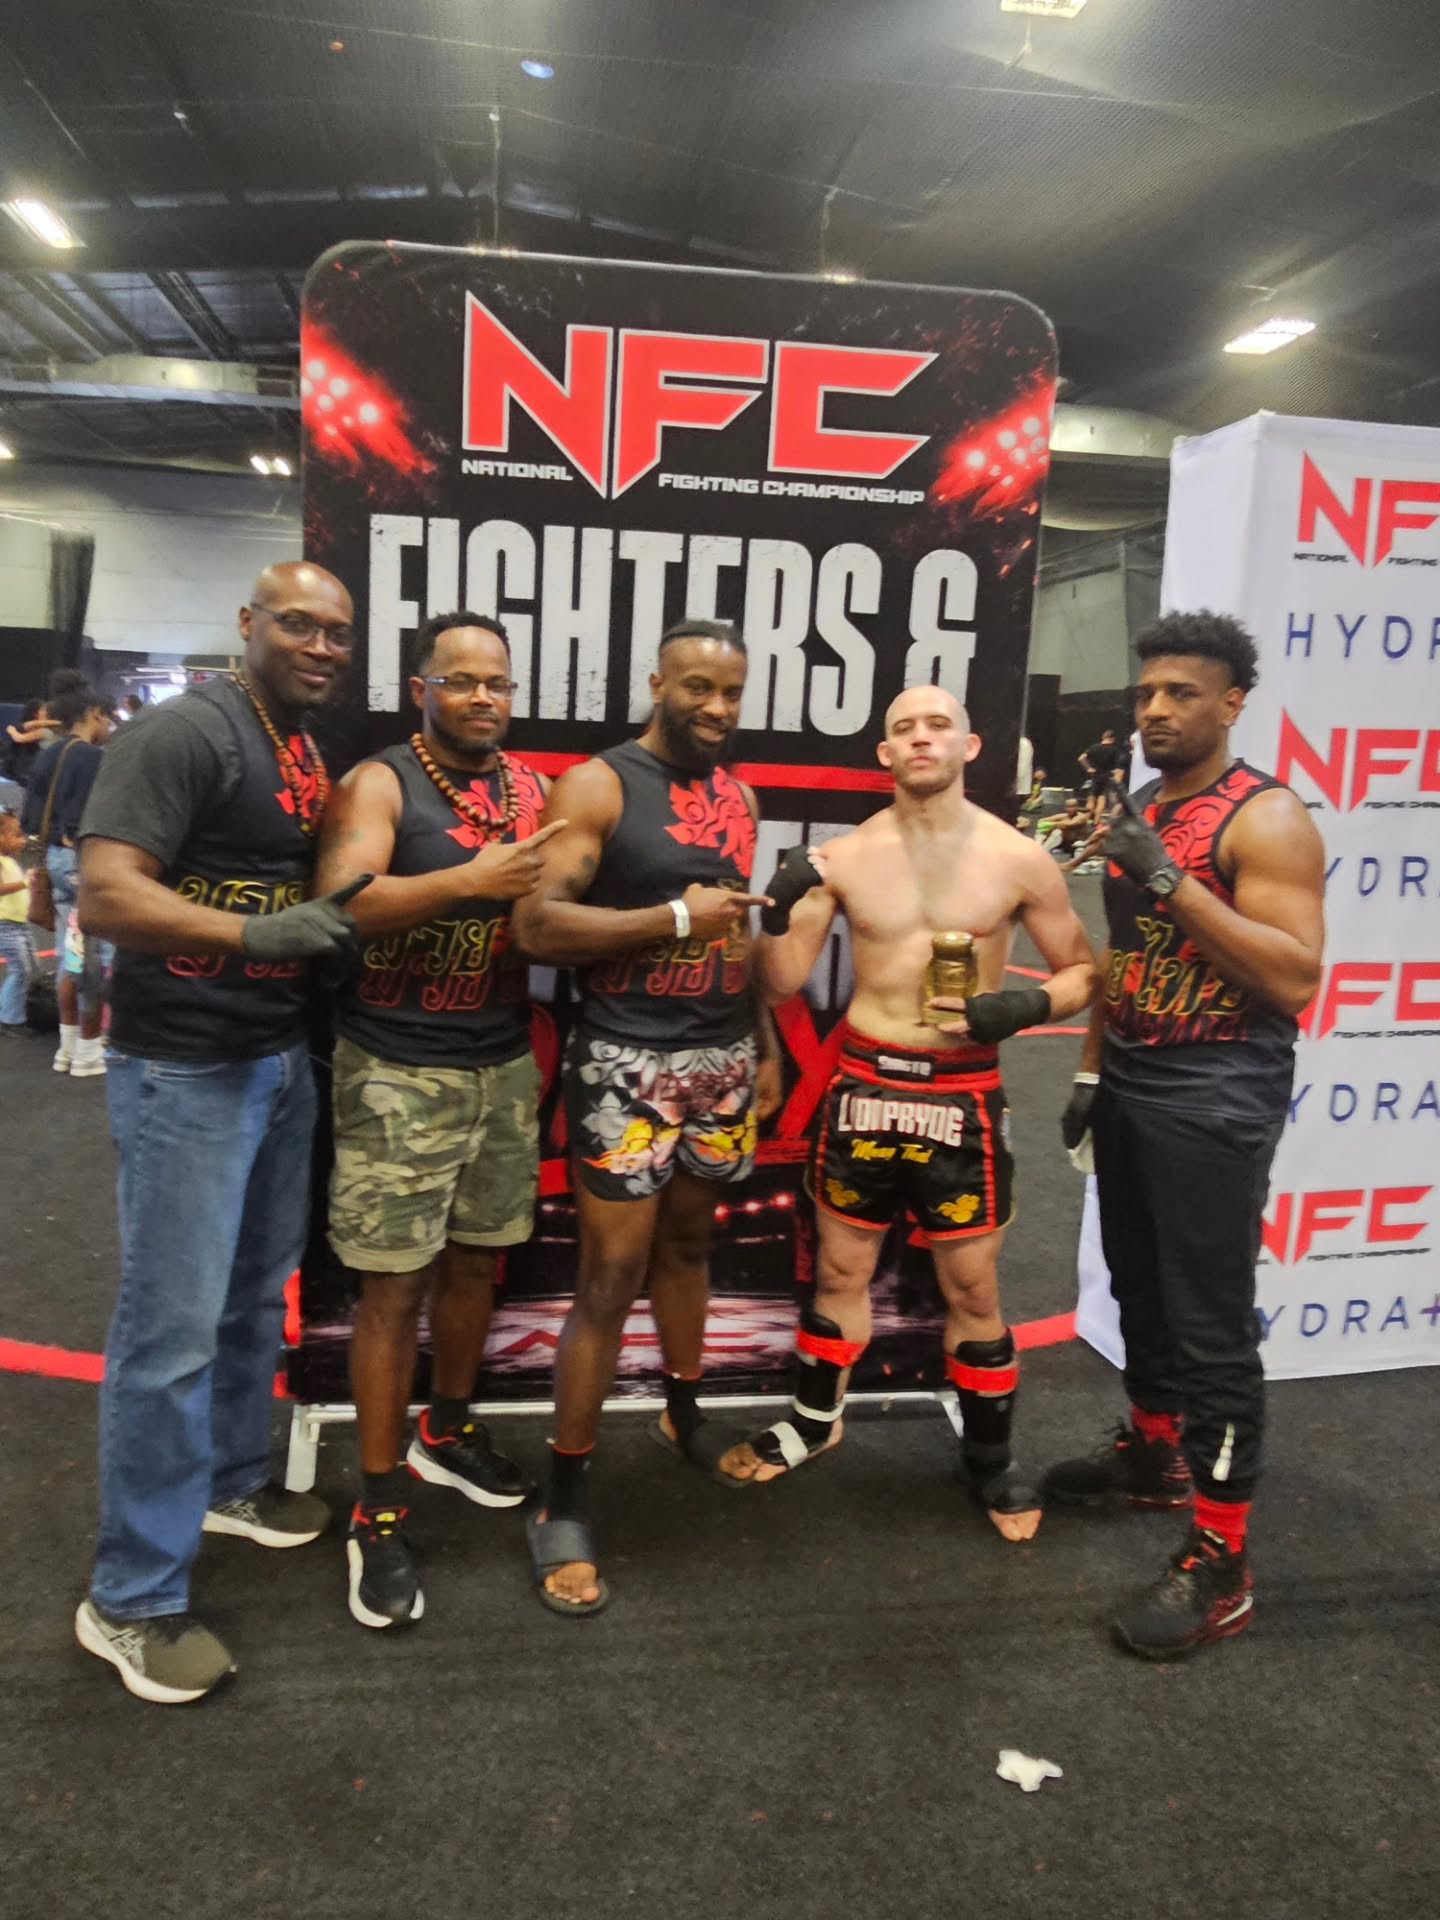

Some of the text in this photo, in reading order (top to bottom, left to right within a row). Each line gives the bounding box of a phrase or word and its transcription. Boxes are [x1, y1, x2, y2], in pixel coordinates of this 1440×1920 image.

[462, 291, 940, 500] NFC
[461, 459, 925, 505] NATIONAL FIGHTING CHAMPIONSHIP
[904, 549, 978, 706] &
